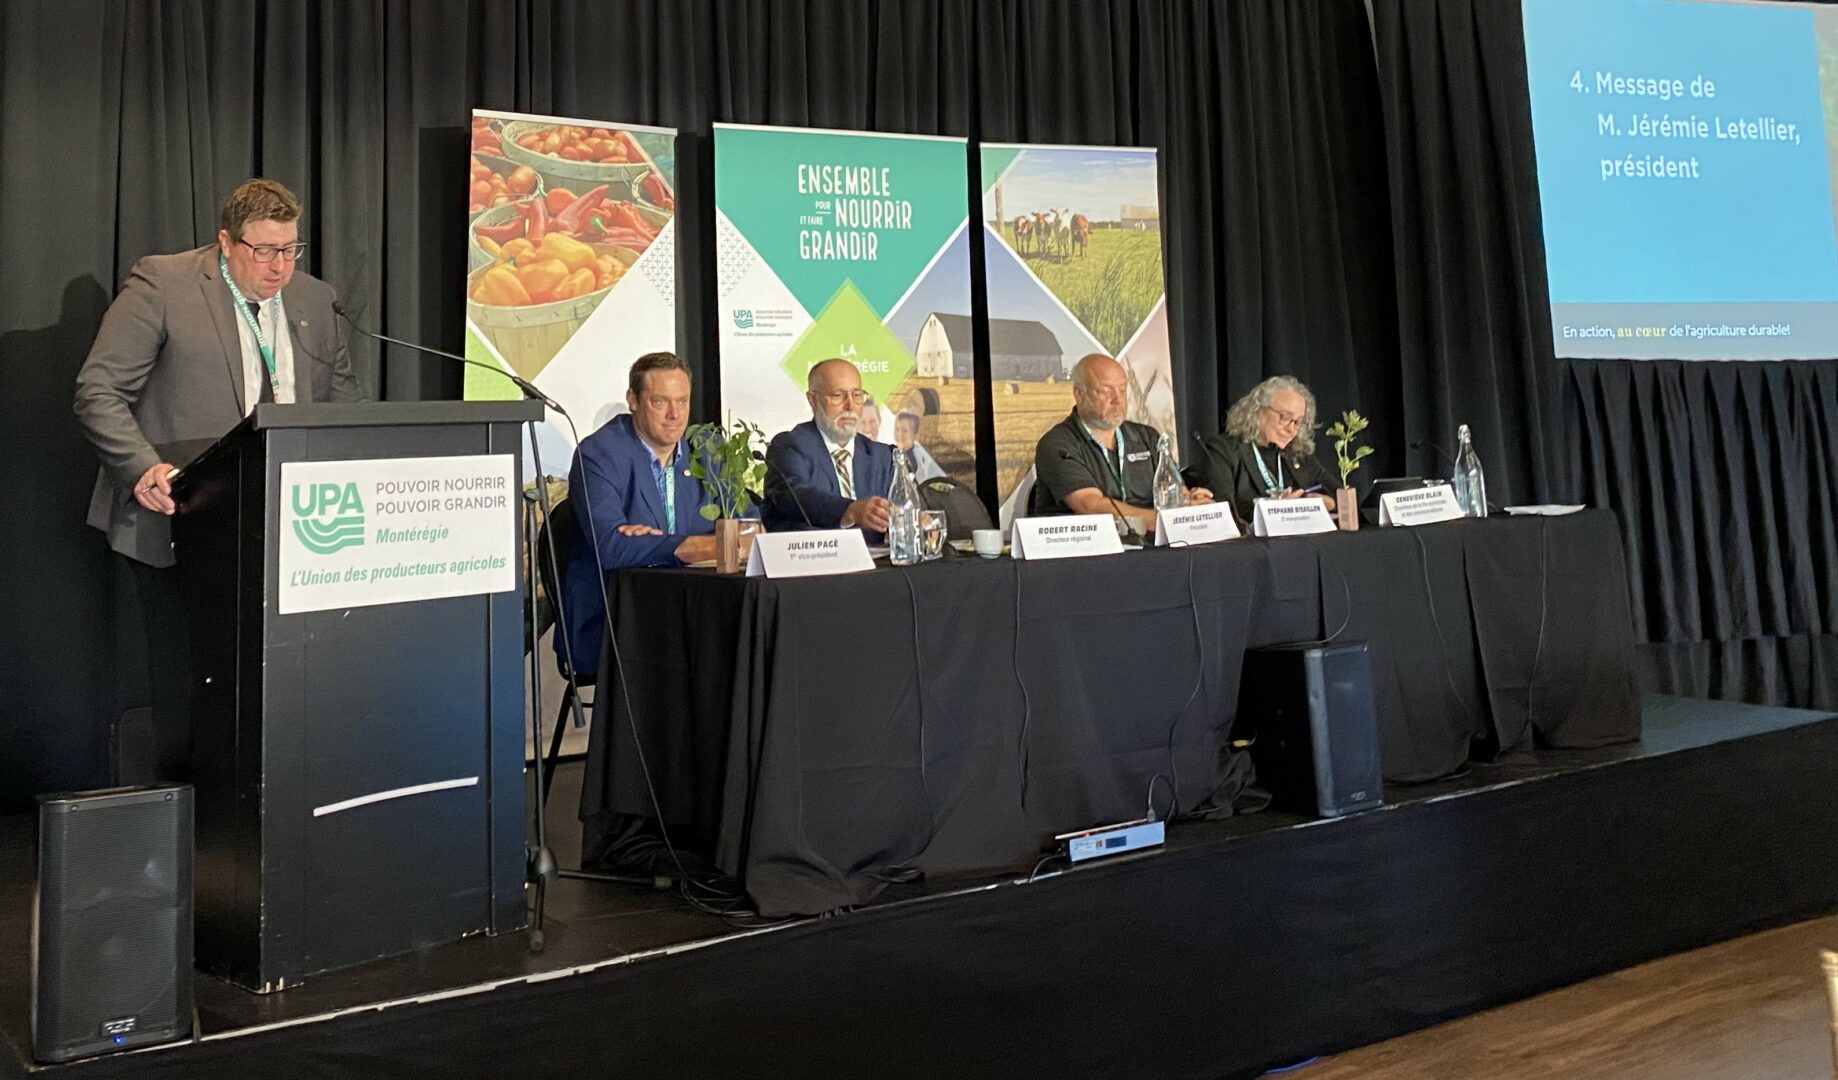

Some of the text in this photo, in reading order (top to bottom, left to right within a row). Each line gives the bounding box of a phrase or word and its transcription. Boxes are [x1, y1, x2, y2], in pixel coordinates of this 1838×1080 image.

[1569, 70, 1716, 100] 4. Message de
[1597, 113, 1800, 145] M. Jérémie Letellier,
[1601, 154, 1699, 181] président
[798, 164, 891, 197] ENSEMBLE
[815, 201, 831, 210] POUR
[800, 216, 824, 226] ET FAIRE
[733, 309, 753, 319] UPA
[242, 305, 267, 348] NOURRIR
[1563, 323, 1791, 339] En action, au cœur de l'agriculture durable!
[840, 344, 857, 356] LA
[376, 477, 506, 495] POUVOIR NOURRIR
[292, 482, 365, 518] UPA
[376, 496, 507, 515] POUVOIR GRANDIR
[1196, 512, 1223, 521] LETELLIER
[376, 525, 449, 545] Montérégie
[1038, 524, 1098, 534] ROBERT RACINE
[788, 539, 838, 551] JULIEN PAGÉ
[290, 555, 506, 587] L'Union des producteurs agricoles
